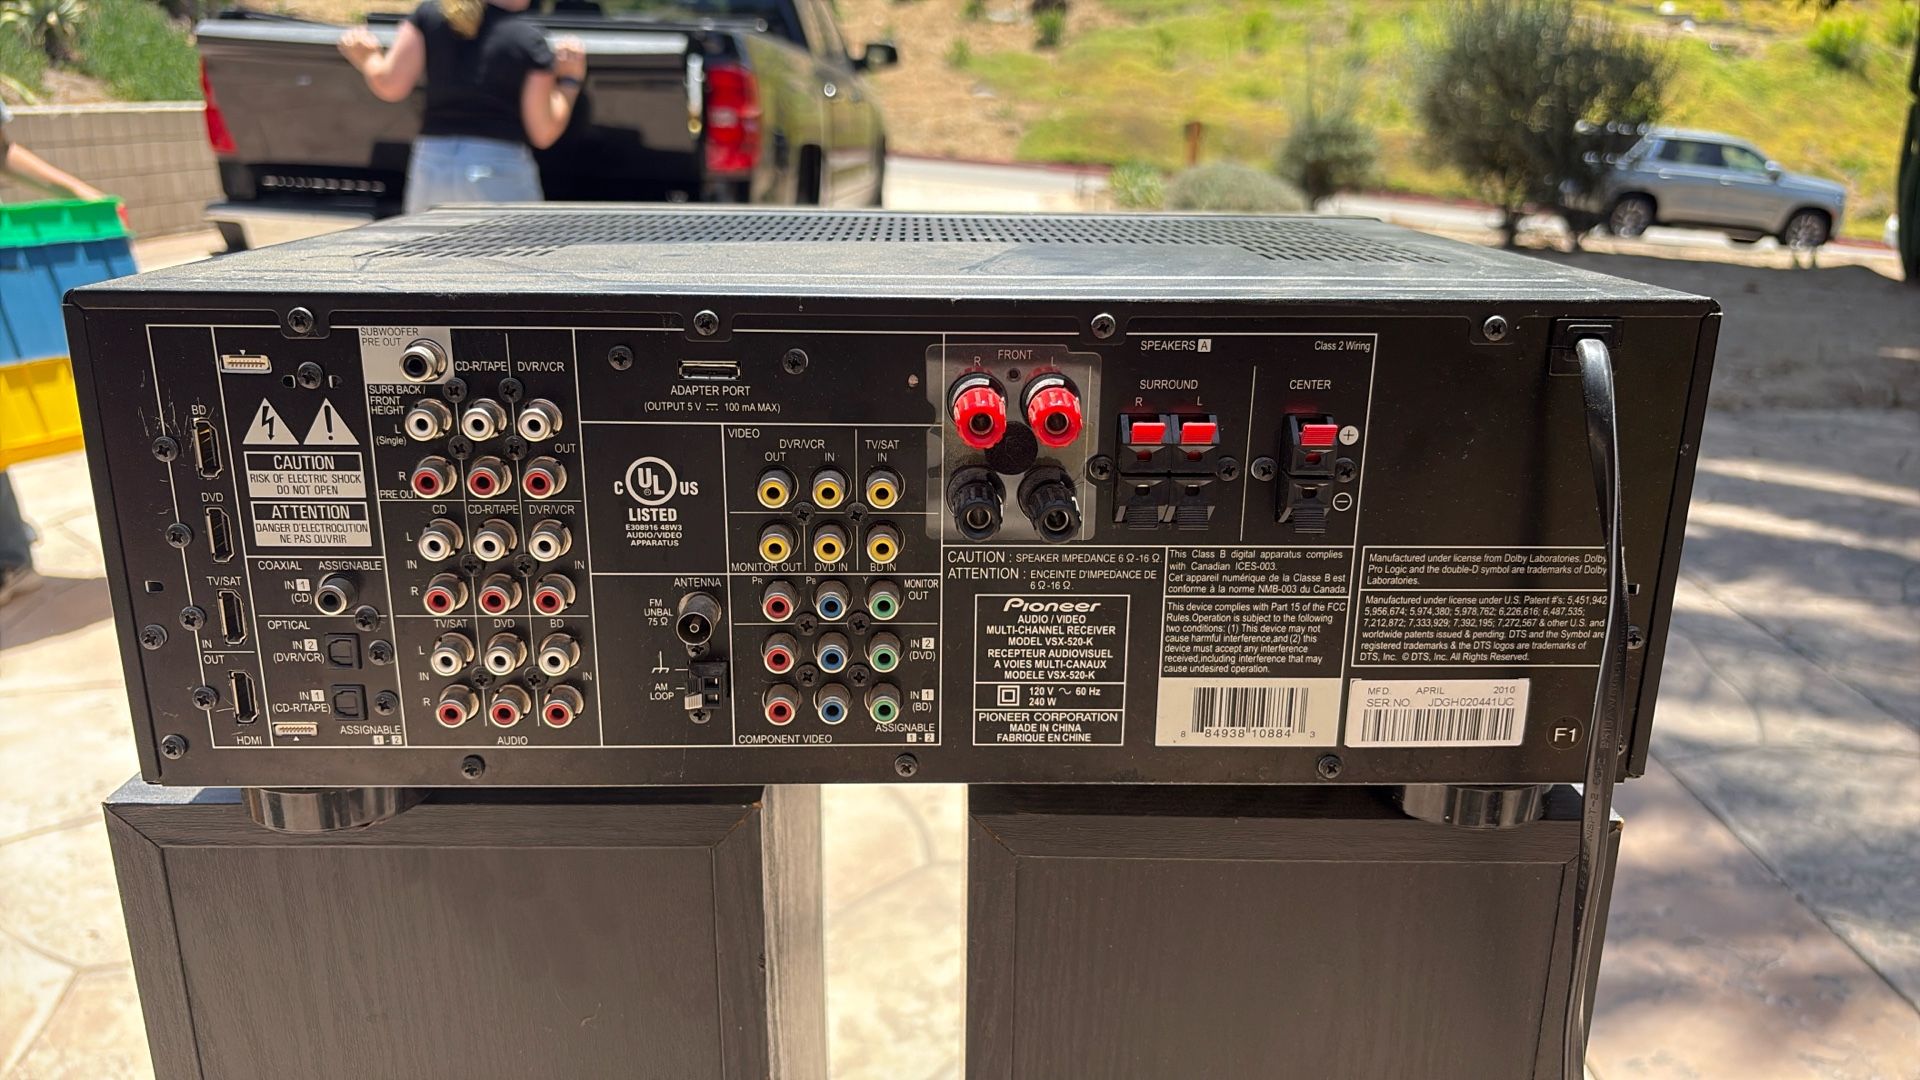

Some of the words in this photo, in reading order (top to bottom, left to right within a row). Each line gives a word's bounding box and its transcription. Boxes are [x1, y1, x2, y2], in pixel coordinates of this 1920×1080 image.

[360, 328, 419, 336] SUBWOOFER
[362, 338, 380, 346] PRE
[383, 338, 401, 346] OUT
[1140, 341, 1196, 351] SPEAKERS
[1314, 341, 1337, 351] Class
[1338, 341, 1344, 351] 2
[1345, 341, 1371, 352] Wiring
[997, 350, 1032, 360] FRONT
[455, 361, 508, 372] CD-R/TAPE
[517, 361, 565, 372] DVR/VCR
[1139, 380, 1198, 389] SURROUND
[1289, 380, 1331, 389] CENTER
[369, 385, 395, 394] SURR
[396, 385, 421, 394] BACK
[670, 385, 719, 396] ADAPTER
[722, 385, 751, 396] PORT
[370, 396, 401, 405] FRONT
[1135, 397, 1143, 407] R
[1197, 396, 1203, 406] L
[191, 404, 206, 415] BD
[371, 406, 405, 415] HEIGHT
[644, 402, 685, 413] (OUTPUT
[687, 402, 694, 411] 5
[694, 402, 701, 411] V
[724, 403, 740, 412] 100
[742, 403, 756, 412] mA
[758, 403, 781, 414] MAX)
[728, 429, 760, 438] VIDEO
[376, 436, 407, 446] (Single)
[779, 440, 825, 449] DVR/VCR
[866, 440, 900, 449] TV/SAT
[554, 444, 576, 454] OUT
[765, 452, 786, 462] OUT
[825, 452, 835, 462] IN
[878, 452, 887, 462] IN
[273, 455, 335, 470] CAUTION
[250, 474, 270, 483] RISK
[273, 474, 285, 483] OF
[288, 474, 328, 483] ELECTRIC
[332, 474, 361, 483] SHOCK
[637, 467, 666, 495] UL
[680, 482, 699, 495] US
[277, 485, 290, 495] DO
[293, 485, 310, 495] NOT
[314, 485, 338, 495] OPEN
[380, 490, 398, 499] PRE
[201, 492, 223, 502] DVD
[272, 505, 350, 519] ATTENTION
[432, 505, 447, 514] CD
[468, 505, 519, 514] CD-R/TAPE
[529, 505, 575, 514] DVR/VCR
[628, 508, 678, 522] LISTED
[256, 523, 291, 532] DANGER
[293, 523, 368, 532] D'ELECTROCUTION
[280, 535, 292, 544] NE
[294, 535, 311, 544] PAS
[314, 535, 347, 544] OUVRIR
[948, 551, 1005, 563] CAUTION
[1015, 554, 1059, 563] SPEAKER
[1062, 554, 1116, 563] IMPEDANCE
[1169, 550, 1187, 558] This
[1192, 550, 1215, 558] Class
[1220, 550, 1226, 558] B
[1231, 550, 1256, 560] digital
[1260, 550, 1301, 560] apparatus
[1306, 550, 1343, 560] complies
[258, 561, 302, 570] COAXIAL
[318, 561, 382, 570] ASSIGNABLE
[407, 560, 417, 569] IN
[574, 560, 584, 569] IN
[731, 563, 778, 572] MONITOR
[782, 563, 802, 572] OUT
[815, 563, 835, 572] DVD
[838, 563, 848, 572] IN
[870, 563, 884, 572] BD
[887, 563, 896, 572] IN
[1169, 562, 1186, 570] with
[1191, 562, 1230, 570] Canadian
[1235, 562, 1278, 570] ICES-003.
[948, 567, 1019, 579] ATTENTION
[1030, 570, 1077, 579] ENCEINTE
[1079, 570, 1141, 579] D'IMPEDANCE
[1143, 570, 1157, 579] DE
[206, 576, 241, 586] TV/SAT
[674, 578, 721, 587] ANTENNA
[904, 579, 938, 588] MONITOR
[291, 593, 312, 604] (CD)
[908, 591, 928, 600] OUT
[1003, 598, 1101, 612] Pioneer
[644, 608, 673, 617] UNBAL
[434, 619, 468, 628] TV/SAT
[494, 619, 515, 628] DVD
[550, 619, 564, 628] BD
[648, 618, 658, 626] 75
[1018, 615, 1049, 624] AUDIO
[1057, 615, 1086, 624] VIDEO
[267, 620, 310, 630] OPTICAL
[986, 626, 1064, 635] MULTI-CHANNEL
[1067, 626, 1116, 635] RECEIVER
[202, 640, 212, 649] IN
[1008, 637, 1042, 646] MODEL
[1045, 637, 1093, 646] VSX-520-K
[273, 652, 324, 664] (DVR/VCR)
[909, 651, 936, 662] (DVD)
[987, 649, 1046, 658] RECEPTEUR
[1048, 649, 1113, 658] AUDIOVISUEL
[203, 655, 224, 664] OUT
[994, 660, 1001, 669] A
[1003, 660, 1032, 669] VOIES
[1034, 660, 1107, 669] MULTI-CANAUX
[419, 672, 430, 681] IN
[582, 672, 592, 681] IN
[1004, 671, 1044, 679] MODELE
[1047, 671, 1095, 679] VSX-520-K
[1029, 687, 1045, 695] 120
[1048, 687, 1054, 695] V
[1076, 687, 1086, 695] 60
[1089, 687, 1100, 695] Hz
[1493, 686, 1516, 694] 2010
[650, 692, 674, 700] LOOP
[1028, 698, 1045, 706] 240
[1047, 698, 1056, 706] W
[272, 703, 331, 713] (CD-R/TAPE)
[912, 703, 932, 713] (BD)
[978, 713, 1030, 722] PIONEER
[1034, 713, 1118, 722] CORPORATION
[340, 725, 401, 734] ASSIGNABLE
[875, 724, 935, 732] ASSIGNABLE
[1010, 724, 1037, 732] MADE
[1040, 724, 1049, 732] IN
[1052, 724, 1081, 732] CHINA
[1204, 728, 1245, 738] 84938
[1252, 728, 1291, 738] 10884
[1554, 728, 1576, 742] F1
[236, 736, 262, 745] HDMI
[497, 736, 528, 745] AUDIO
[738, 734, 800, 744] COMPONENT
[803, 734, 832, 744] VIDEO
[997, 734, 1045, 742] FABRIQUE
[1048, 734, 1061, 742] EN
[1062, 734, 1092, 742] CHINE
